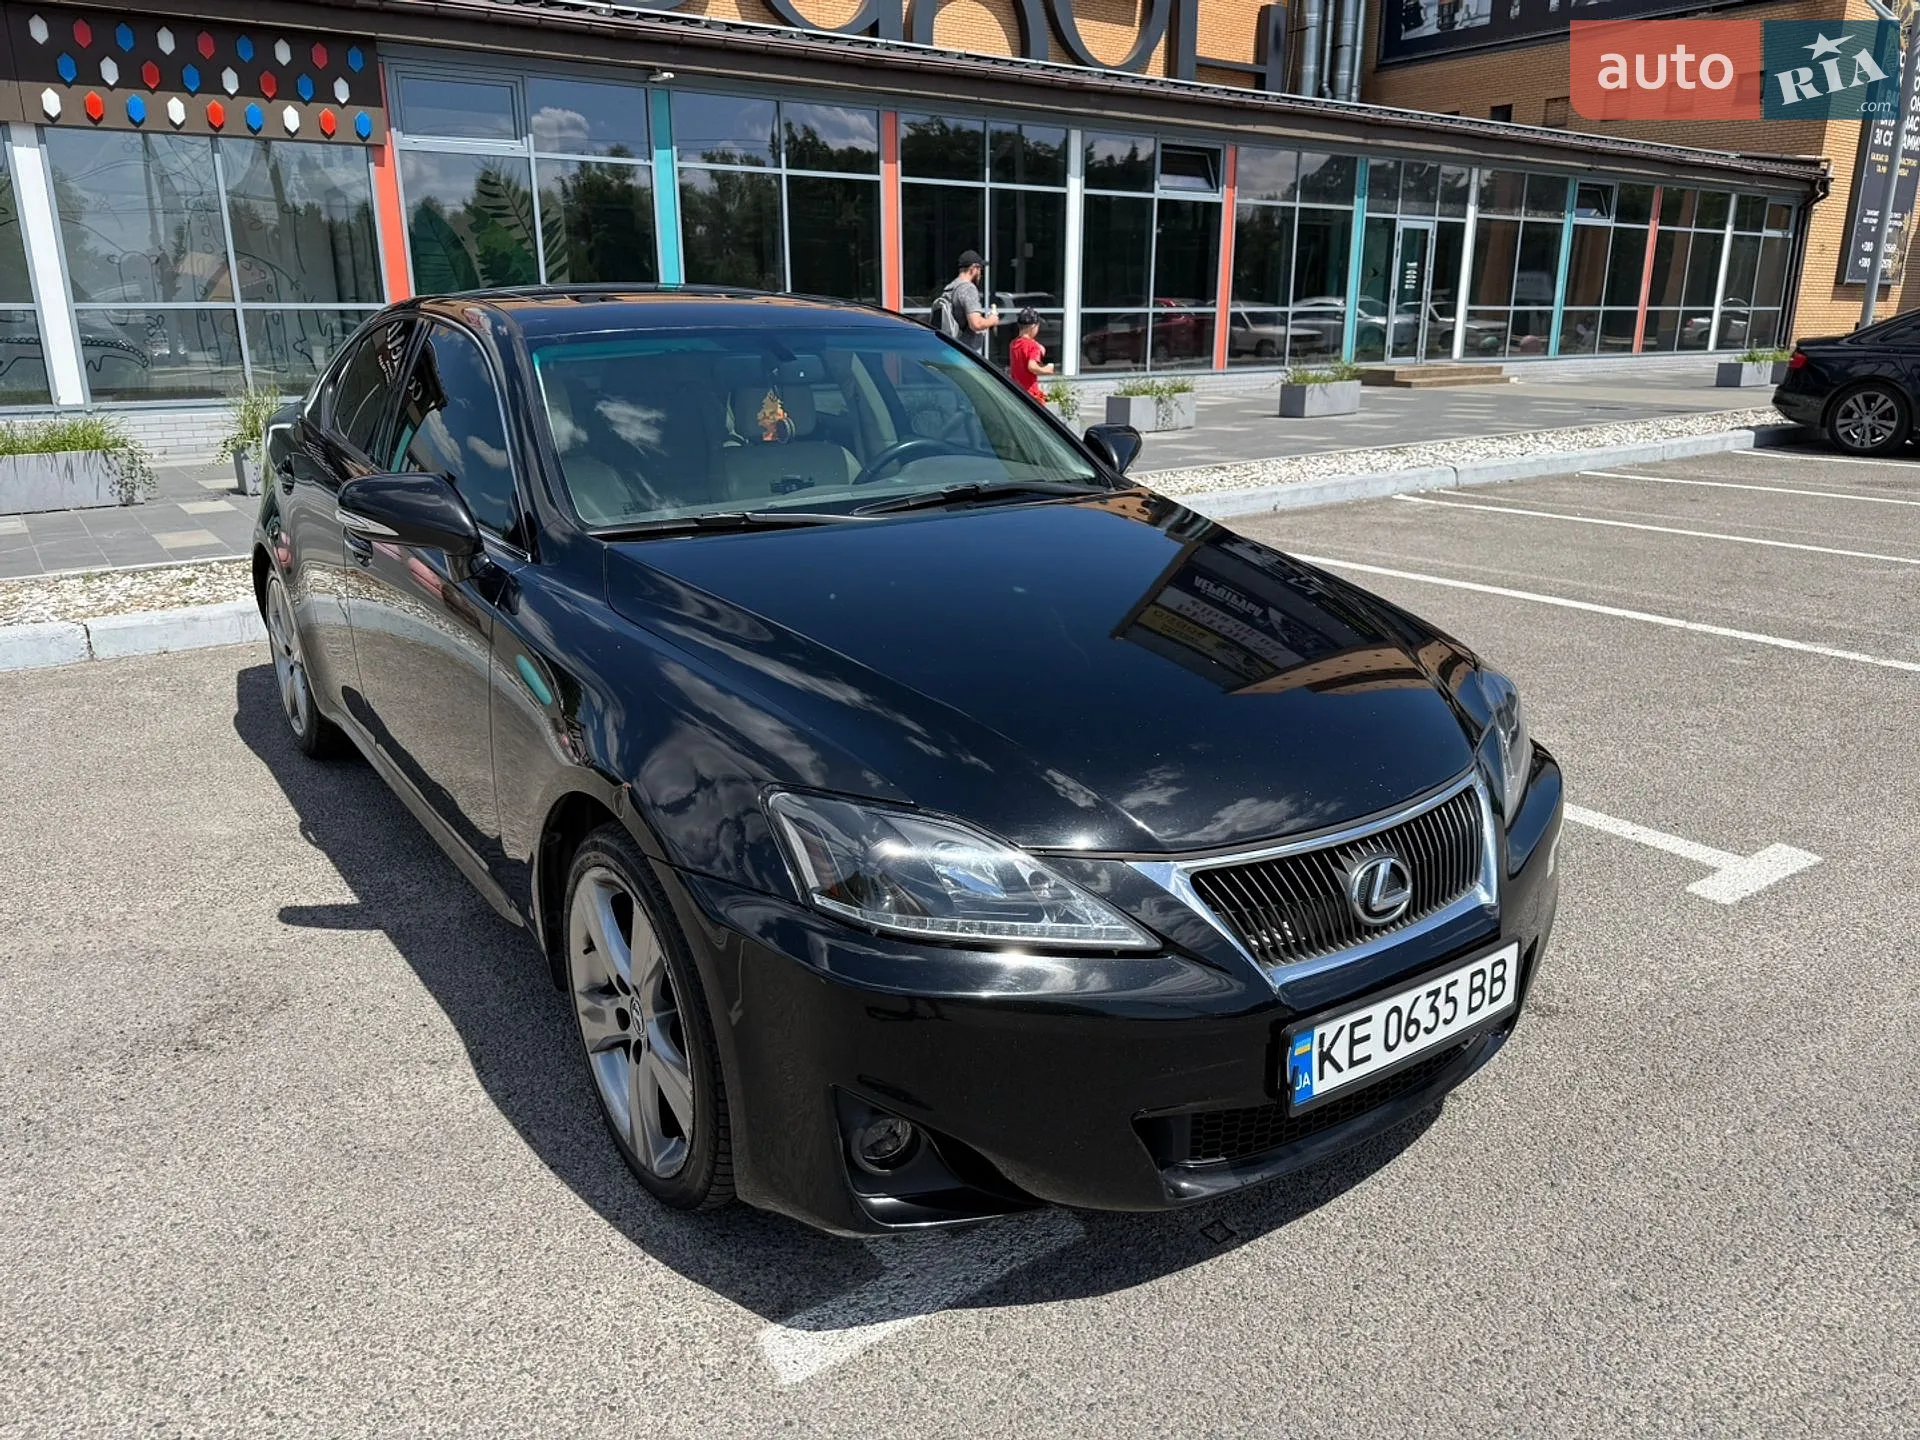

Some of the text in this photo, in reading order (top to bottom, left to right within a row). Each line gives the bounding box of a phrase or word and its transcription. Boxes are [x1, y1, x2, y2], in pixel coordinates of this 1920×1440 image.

[1318, 958, 1507, 1081] KE 0635 BB
